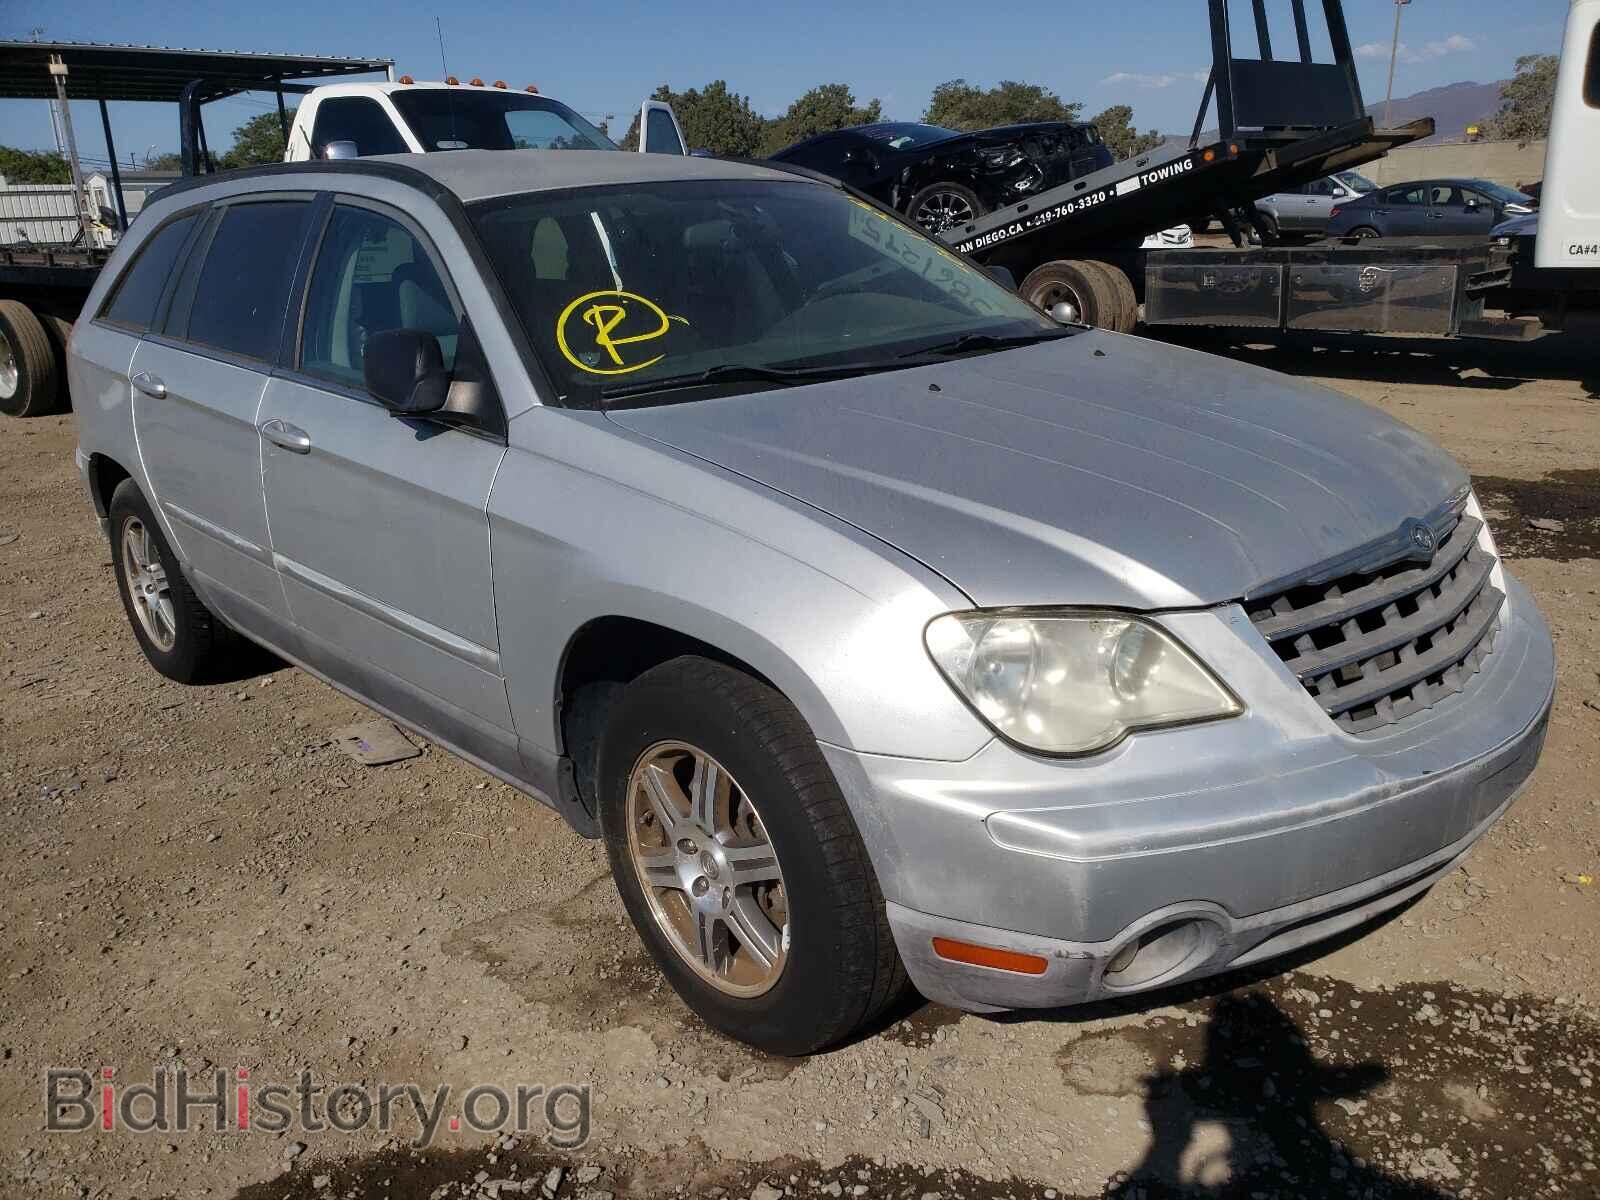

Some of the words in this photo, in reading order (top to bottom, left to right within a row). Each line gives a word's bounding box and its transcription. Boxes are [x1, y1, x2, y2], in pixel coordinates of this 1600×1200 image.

[955, 241, 974, 253] AN
[1140, 158, 1193, 186] TOWING
[1568, 244, 1600, 255] CA#4
